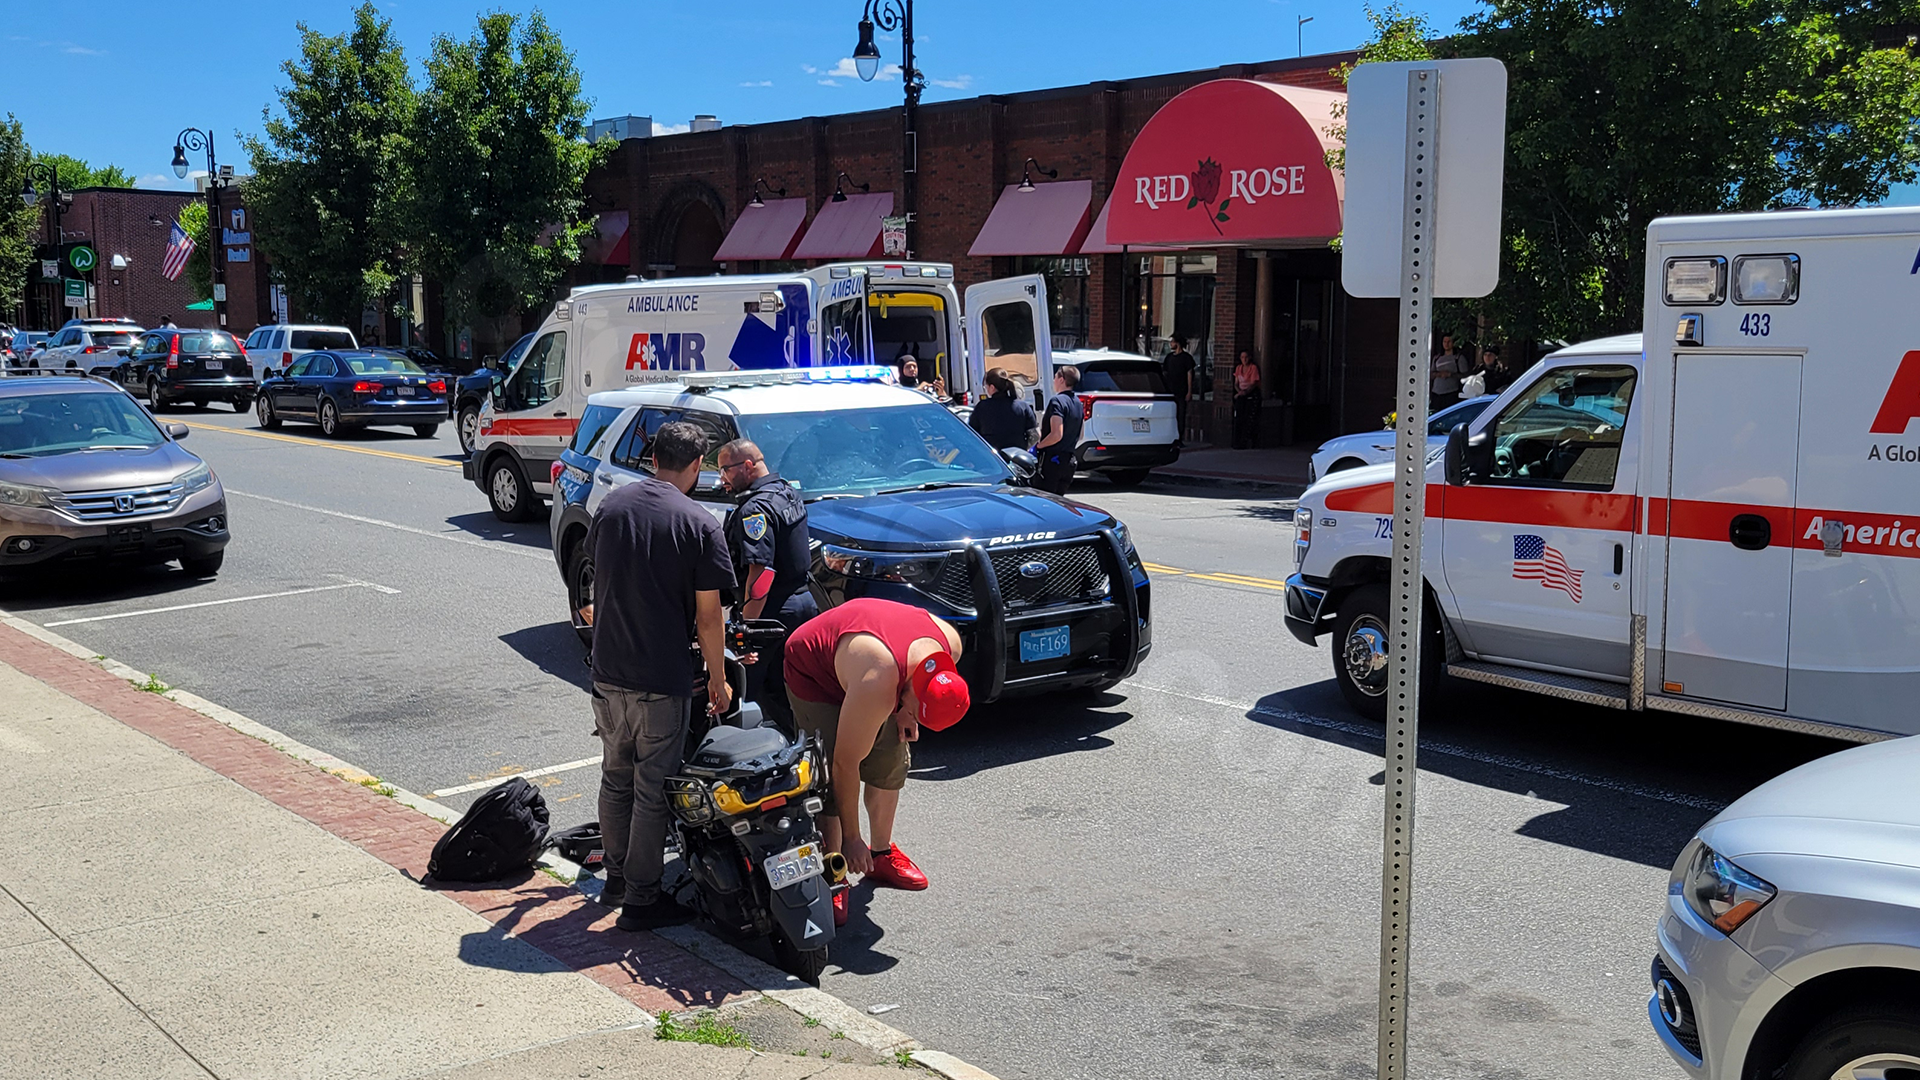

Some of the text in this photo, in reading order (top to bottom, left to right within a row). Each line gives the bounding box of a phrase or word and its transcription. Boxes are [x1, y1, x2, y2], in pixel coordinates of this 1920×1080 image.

[1135, 165, 1306, 210] RED ROSE
[578, 303, 588, 316] 443
[627, 295, 699, 313] AMBULANCE
[1739, 313, 1771, 337] 433
[625, 332, 706, 371] AMR
[630, 374, 644, 383] Global
[1867, 444, 1920, 463] A Glo
[989, 531, 1057, 546] POLICE
[1803, 516, 1920, 549] Aeric
[1040, 634, 1068, 653] F169
[800, 848, 811, 857] 26
[770, 853, 819, 882] 3F5129
